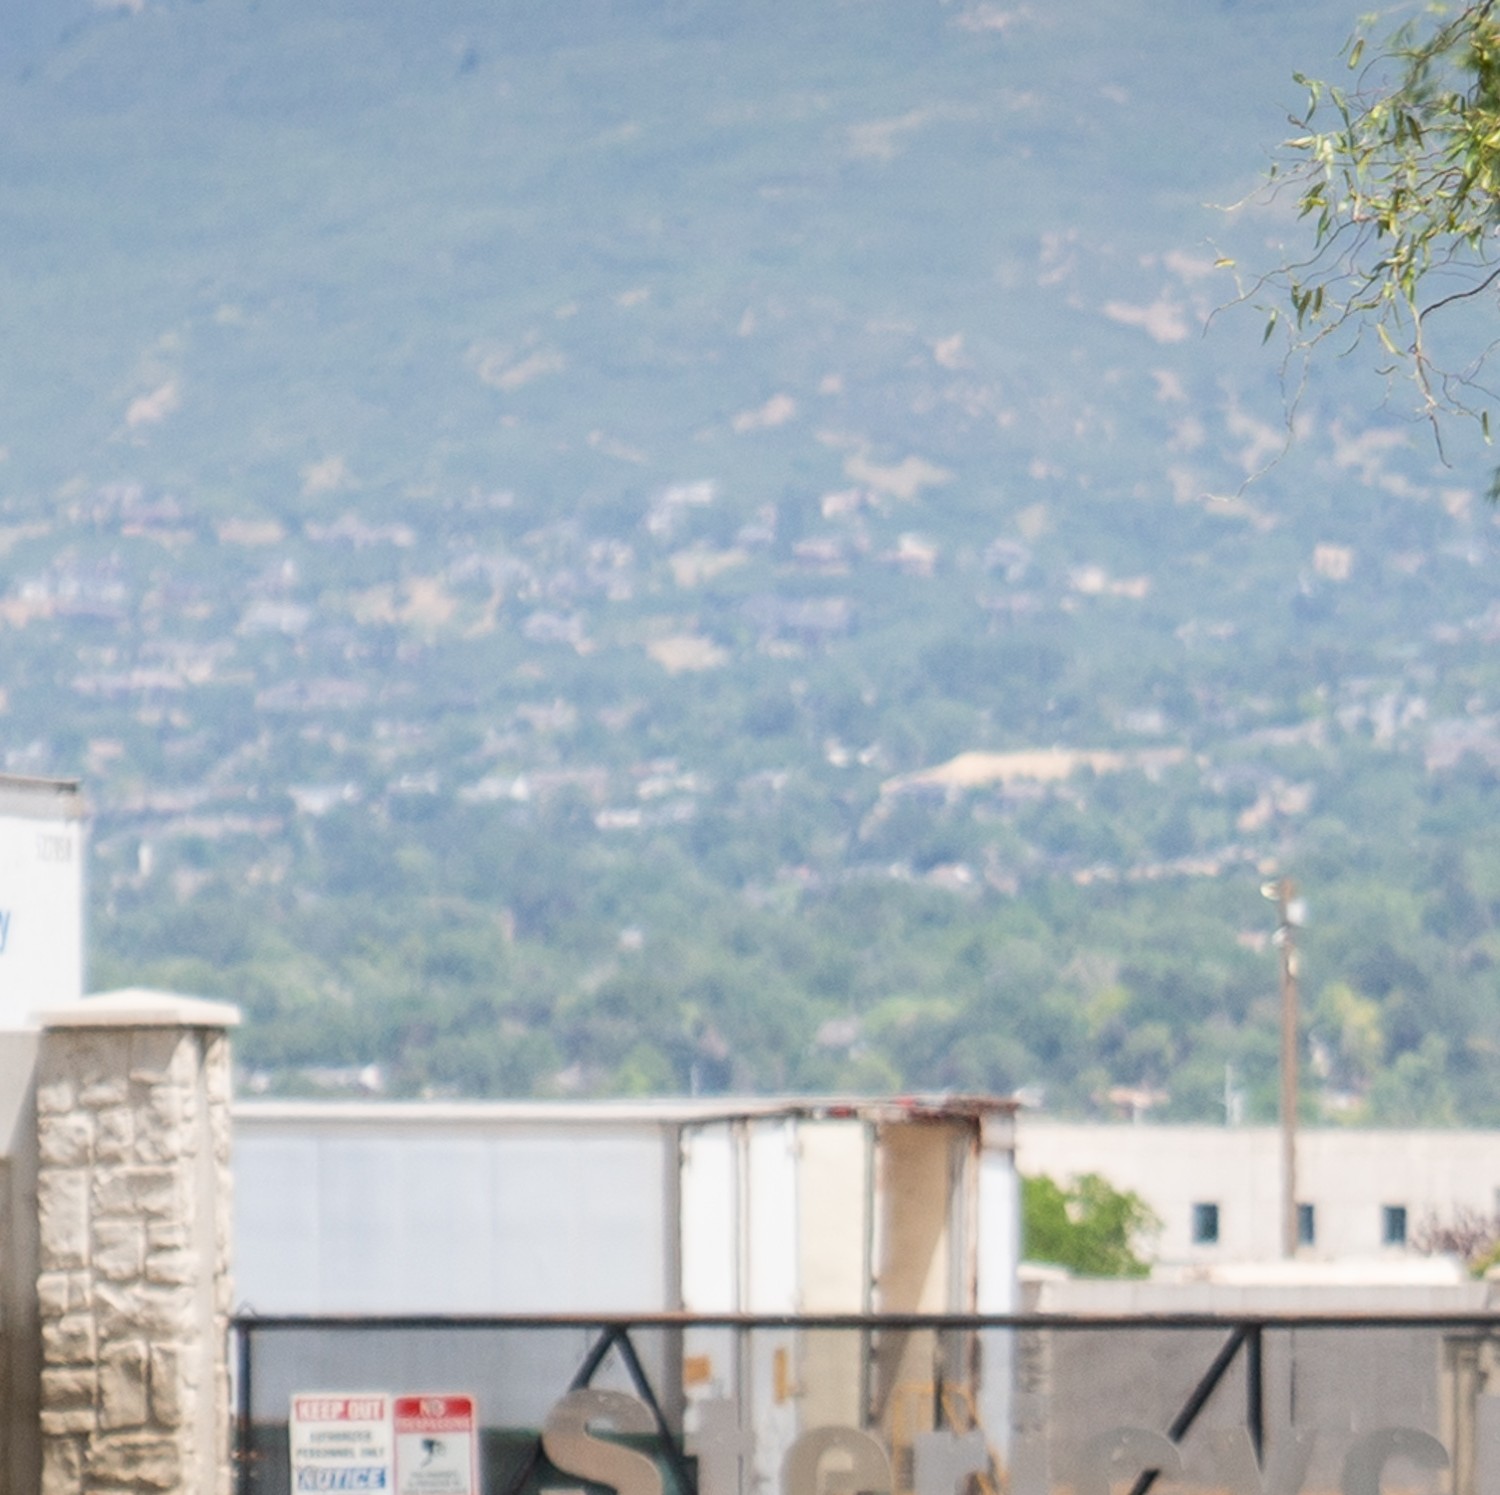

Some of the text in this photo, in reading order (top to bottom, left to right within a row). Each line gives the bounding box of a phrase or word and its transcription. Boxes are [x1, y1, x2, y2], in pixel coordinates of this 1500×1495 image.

[300, 1400, 383, 1420] KEEP OUT
[420, 1399, 446, 1418] NO
[300, 1467, 384, 1489] NOTICE
